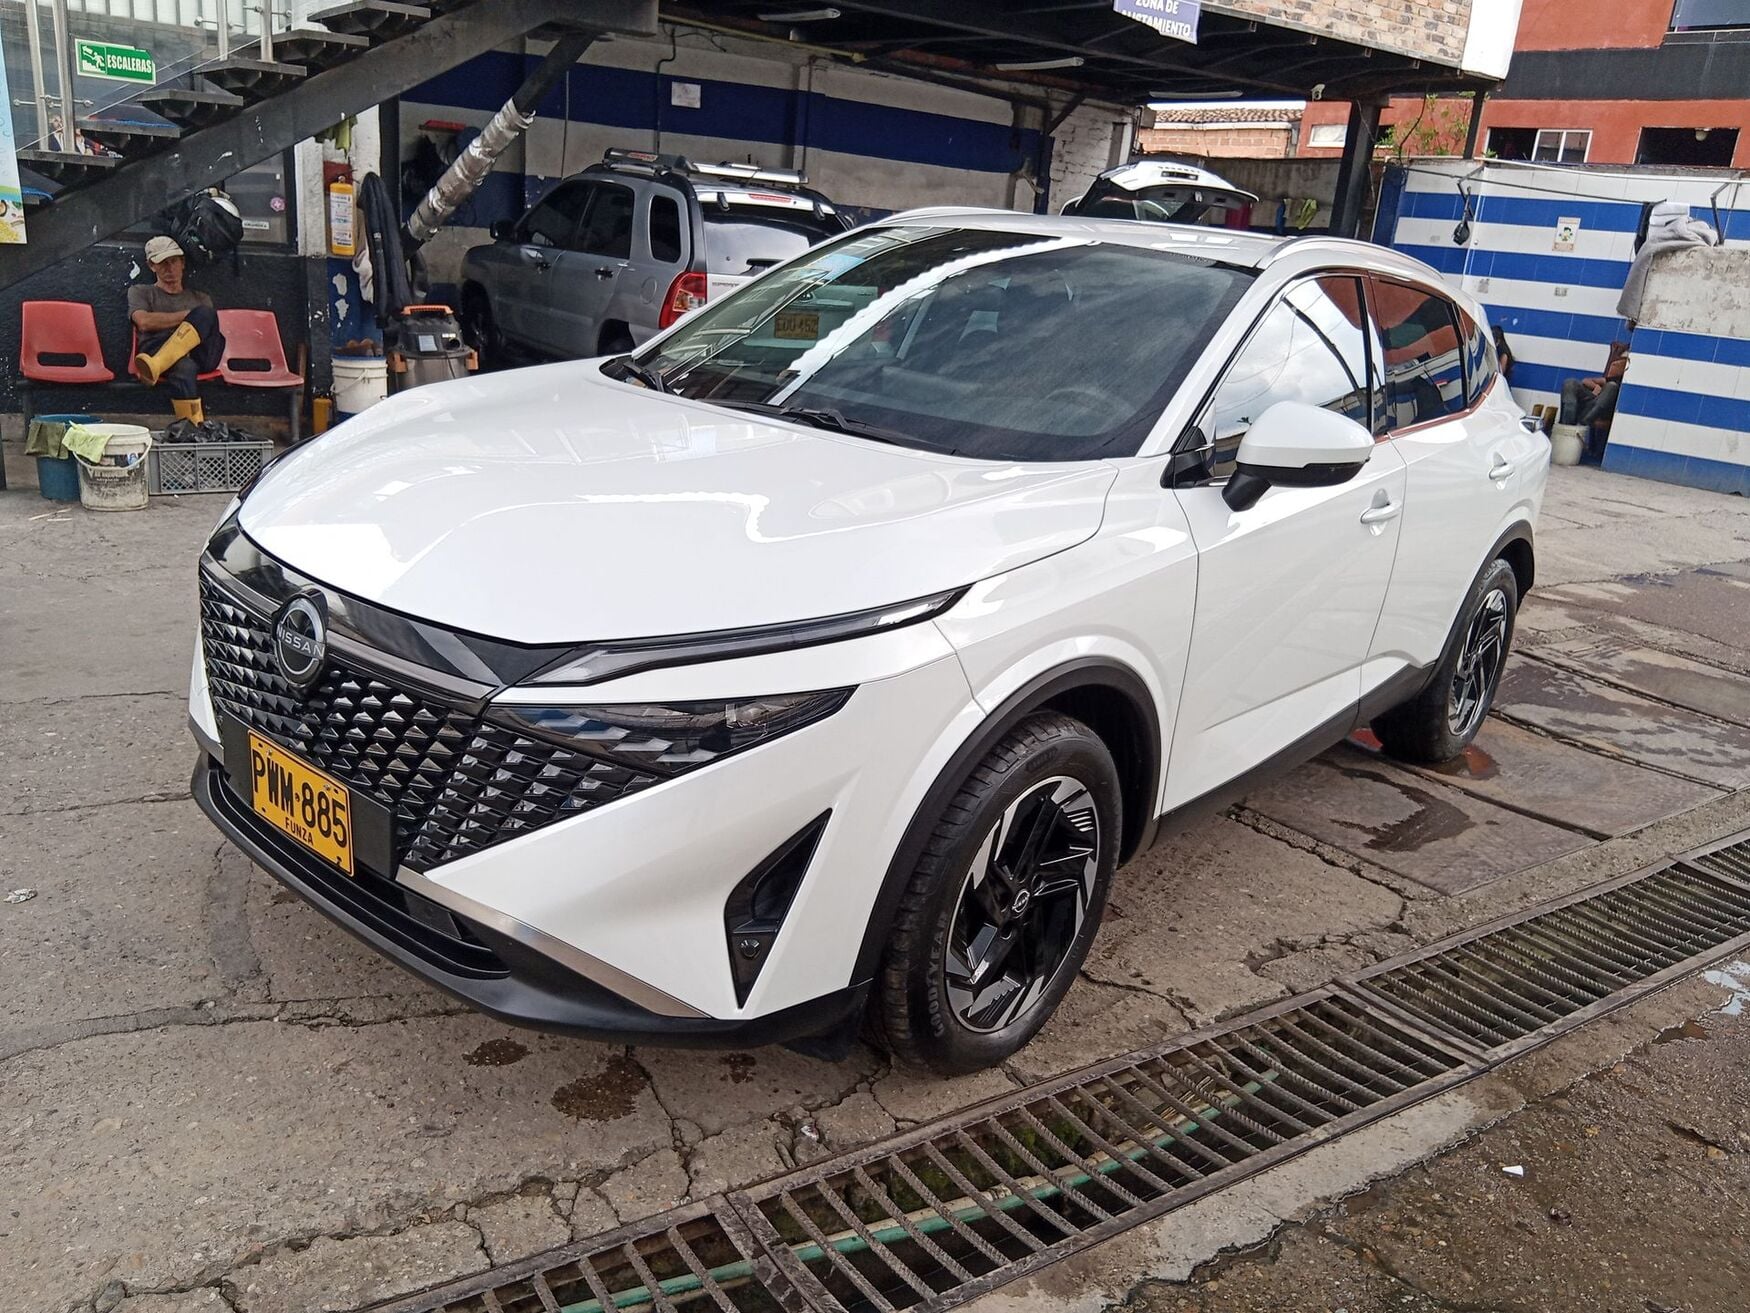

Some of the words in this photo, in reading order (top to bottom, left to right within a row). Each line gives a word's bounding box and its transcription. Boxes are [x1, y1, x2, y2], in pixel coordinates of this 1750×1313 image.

[1165, 0, 1179, 14] DE
[107, 55, 152, 73] ESCALERAS
[276, 624, 325, 658] NISSAN
[285, 817, 314, 846] FUNZA
